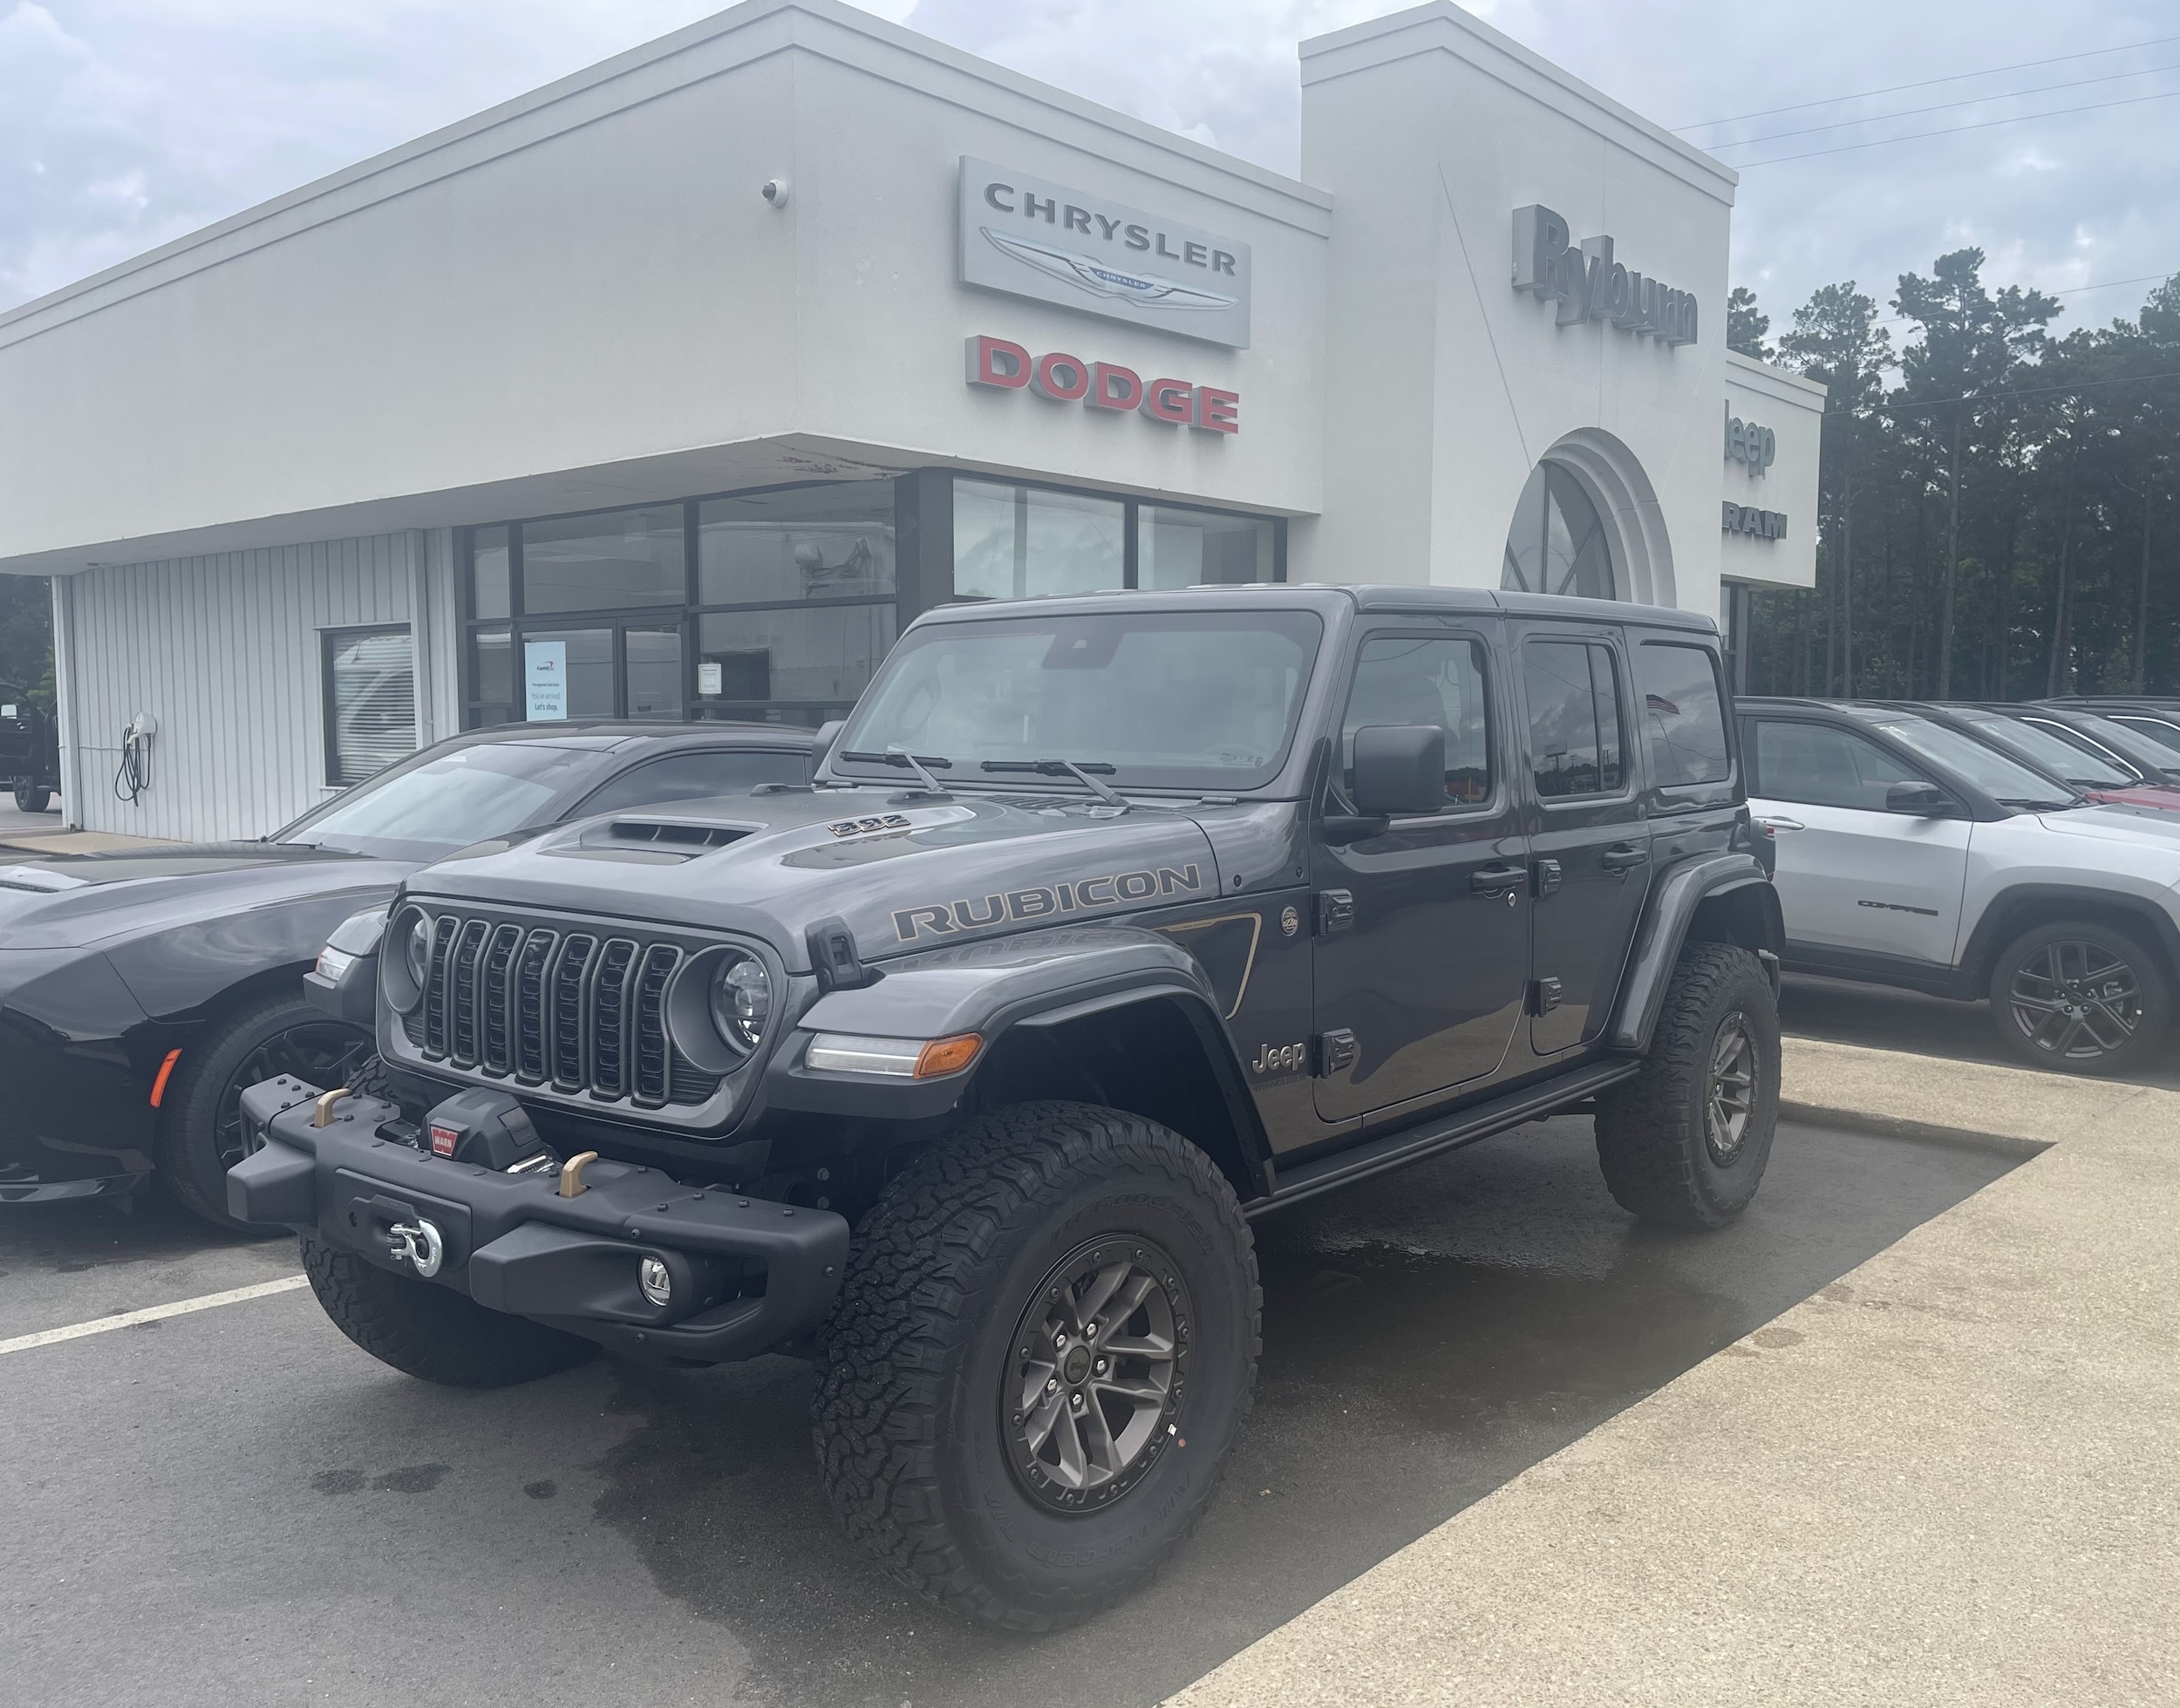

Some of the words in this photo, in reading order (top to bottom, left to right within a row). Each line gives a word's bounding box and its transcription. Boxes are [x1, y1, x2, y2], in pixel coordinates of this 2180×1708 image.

[984, 183, 1236, 277] CHRYSLER
[1096, 271, 1146, 289] CHRYSLER
[1512, 204, 1698, 344] Ryburn
[966, 335, 1239, 434] DODGE
[1721, 500, 1787, 540] RAM
[828, 814, 911, 837] 392
[889, 863, 1202, 942] RUBICON
[1251, 1042, 1306, 1074] Jeep
[434, 1135, 453, 1149] WARN
